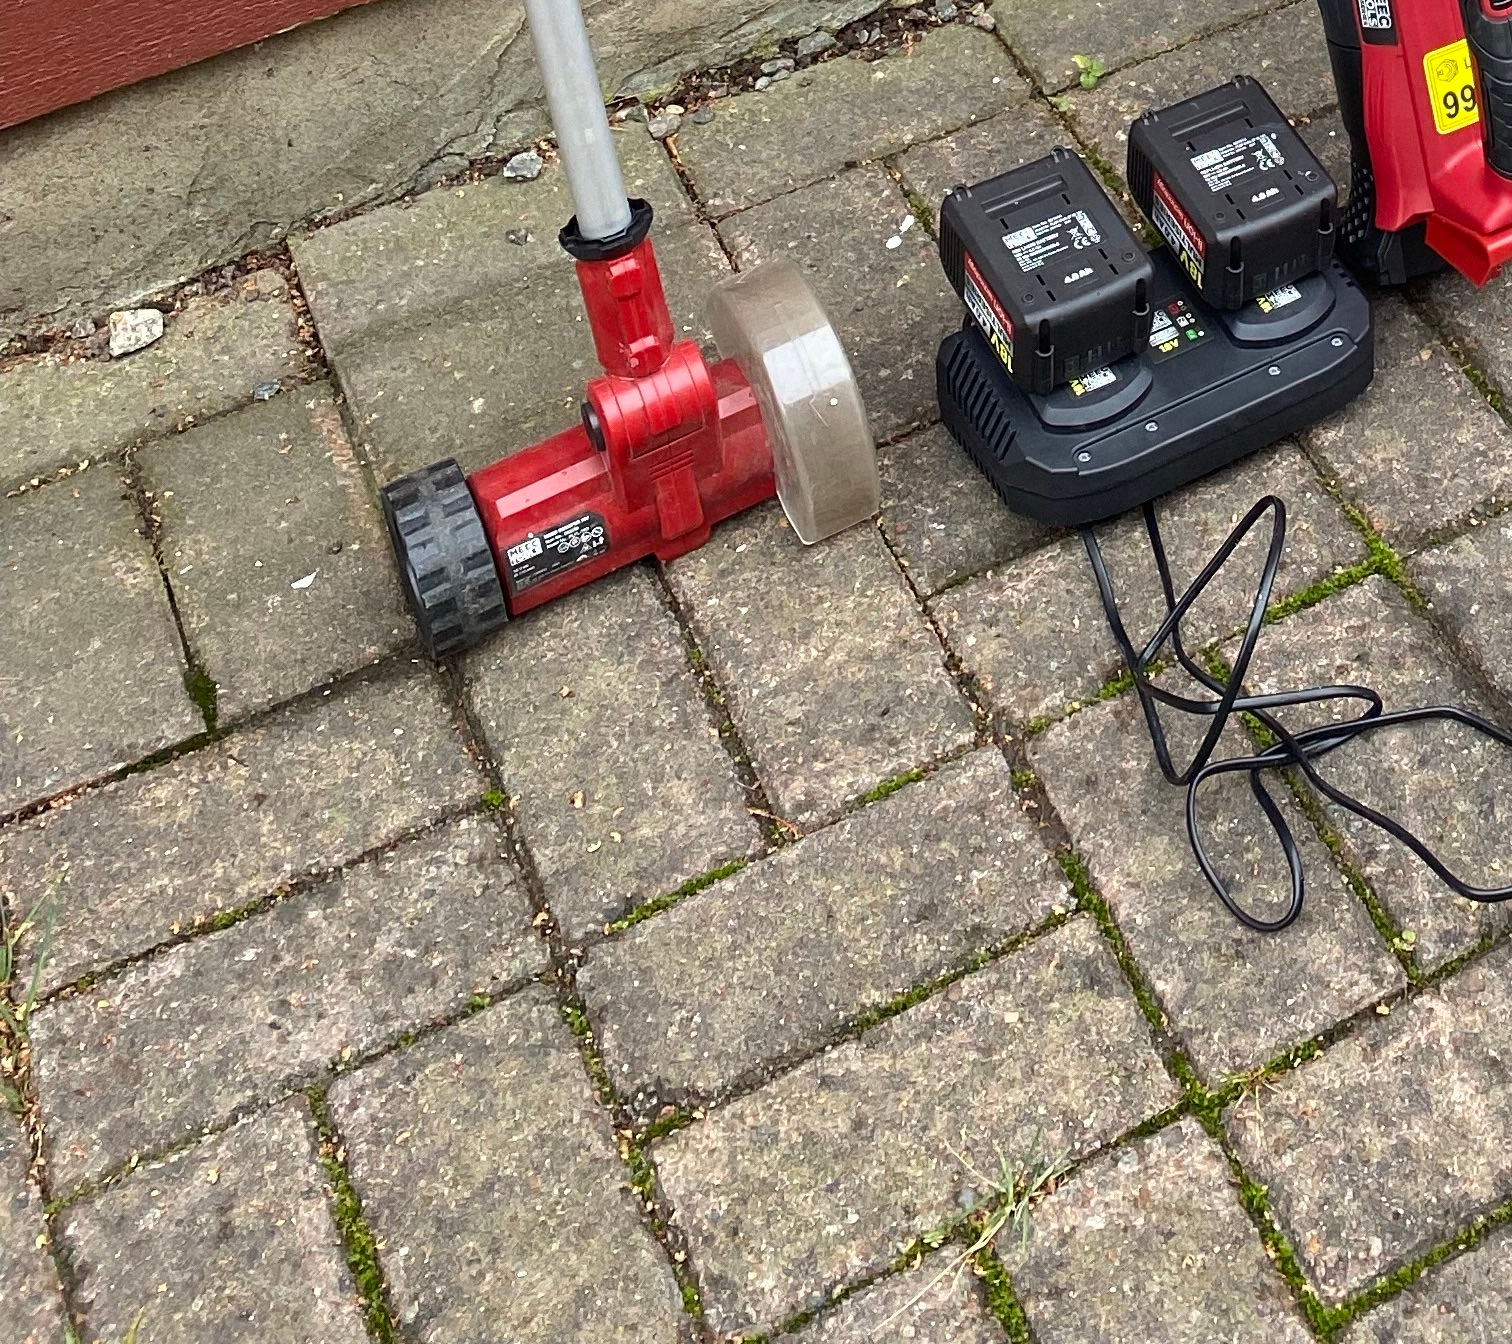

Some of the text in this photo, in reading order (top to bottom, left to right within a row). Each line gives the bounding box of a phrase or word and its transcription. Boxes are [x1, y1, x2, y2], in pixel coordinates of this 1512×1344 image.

[1443, 84, 1477, 119] 99
[1180, 250, 1203, 290] 18V
[991, 332, 1014, 374] 18V
[1158, 338, 1179, 353] 18V
